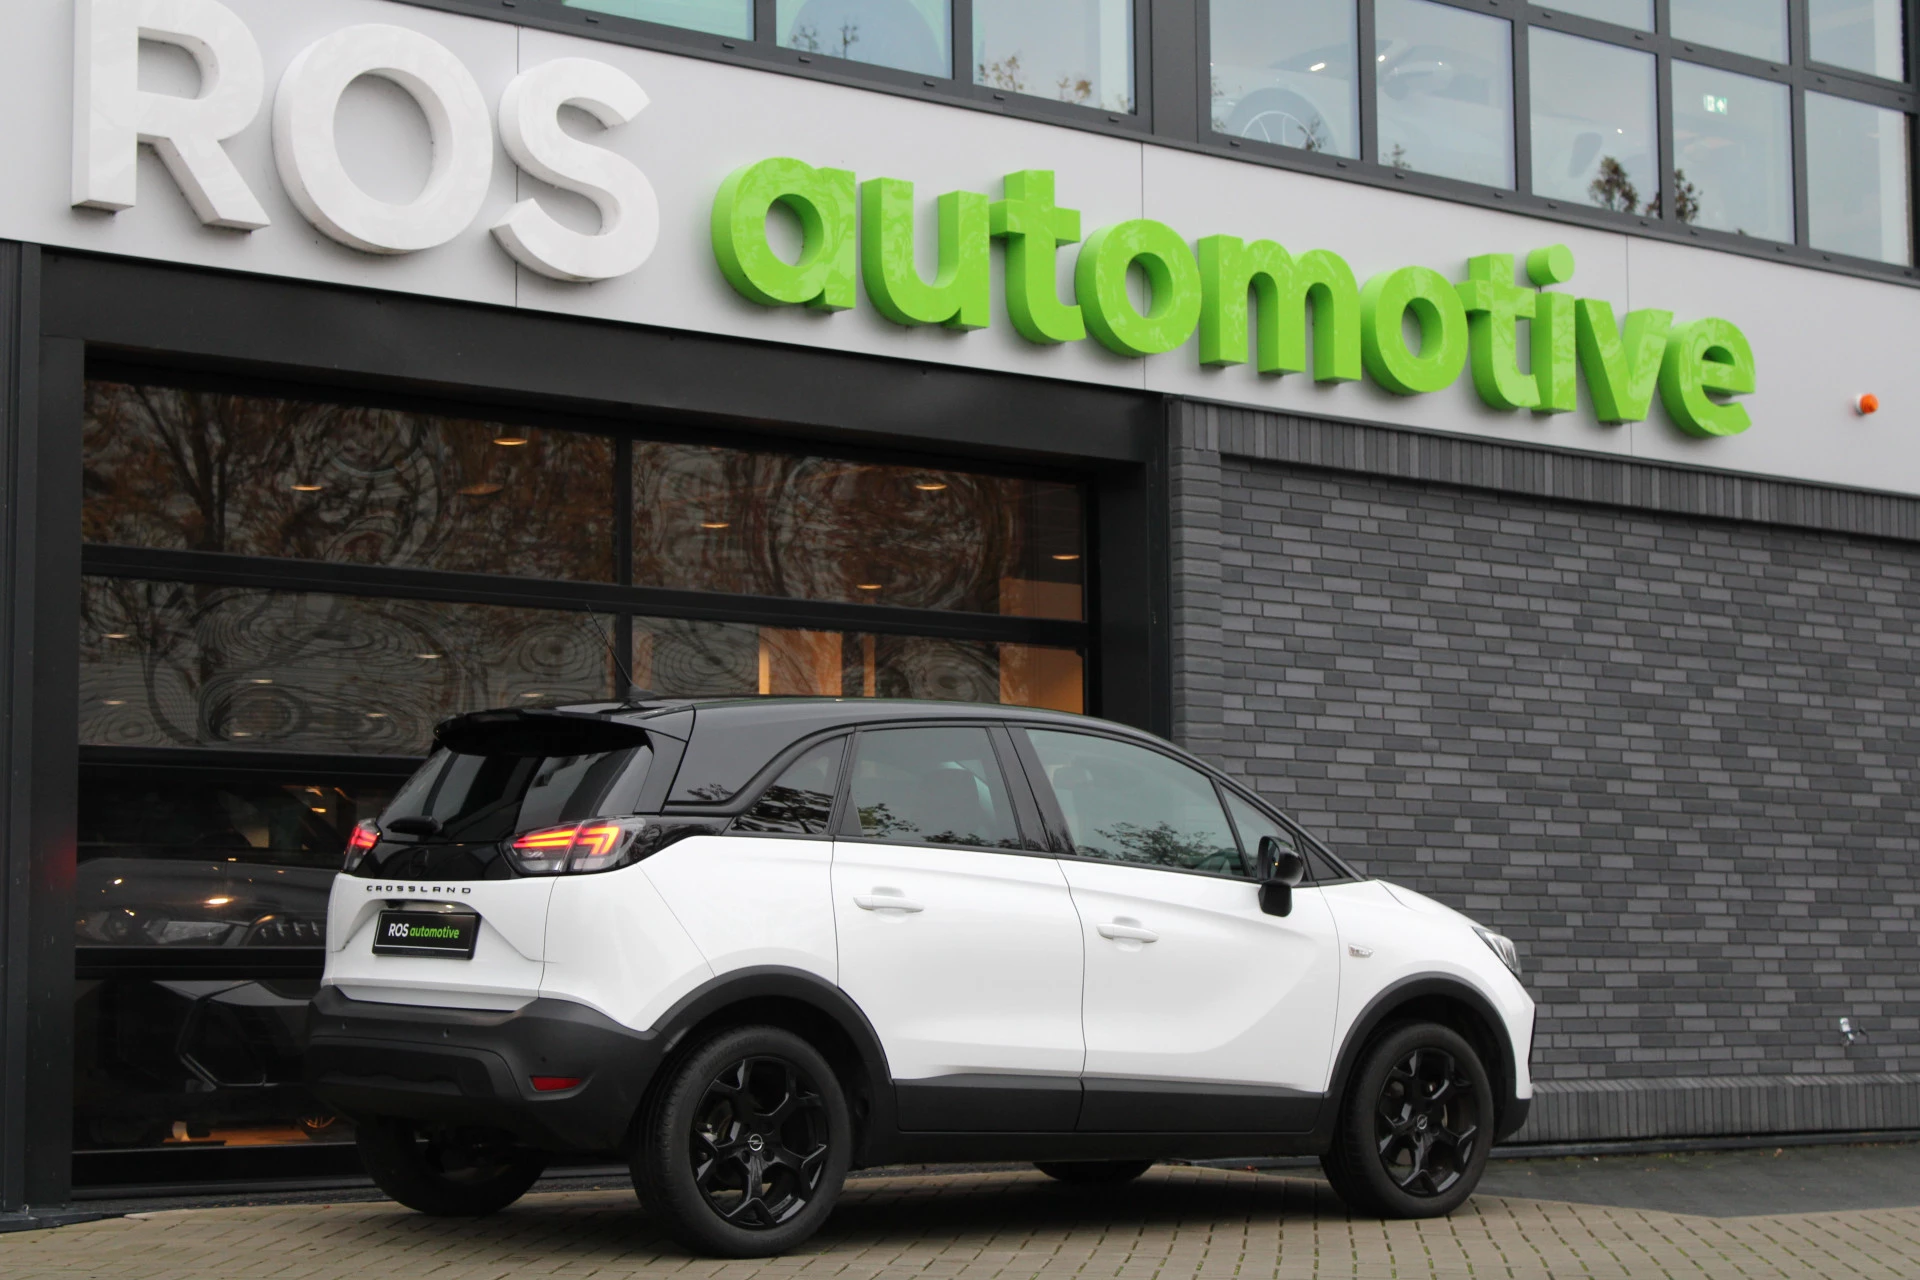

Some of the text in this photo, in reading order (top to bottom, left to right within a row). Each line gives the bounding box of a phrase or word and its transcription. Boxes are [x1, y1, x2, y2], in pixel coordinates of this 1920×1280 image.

[71, 0, 1756, 438] ROS automotive
[366, 885, 471, 894] CROSSLAND
[388, 923, 460, 939] ROS automotive
